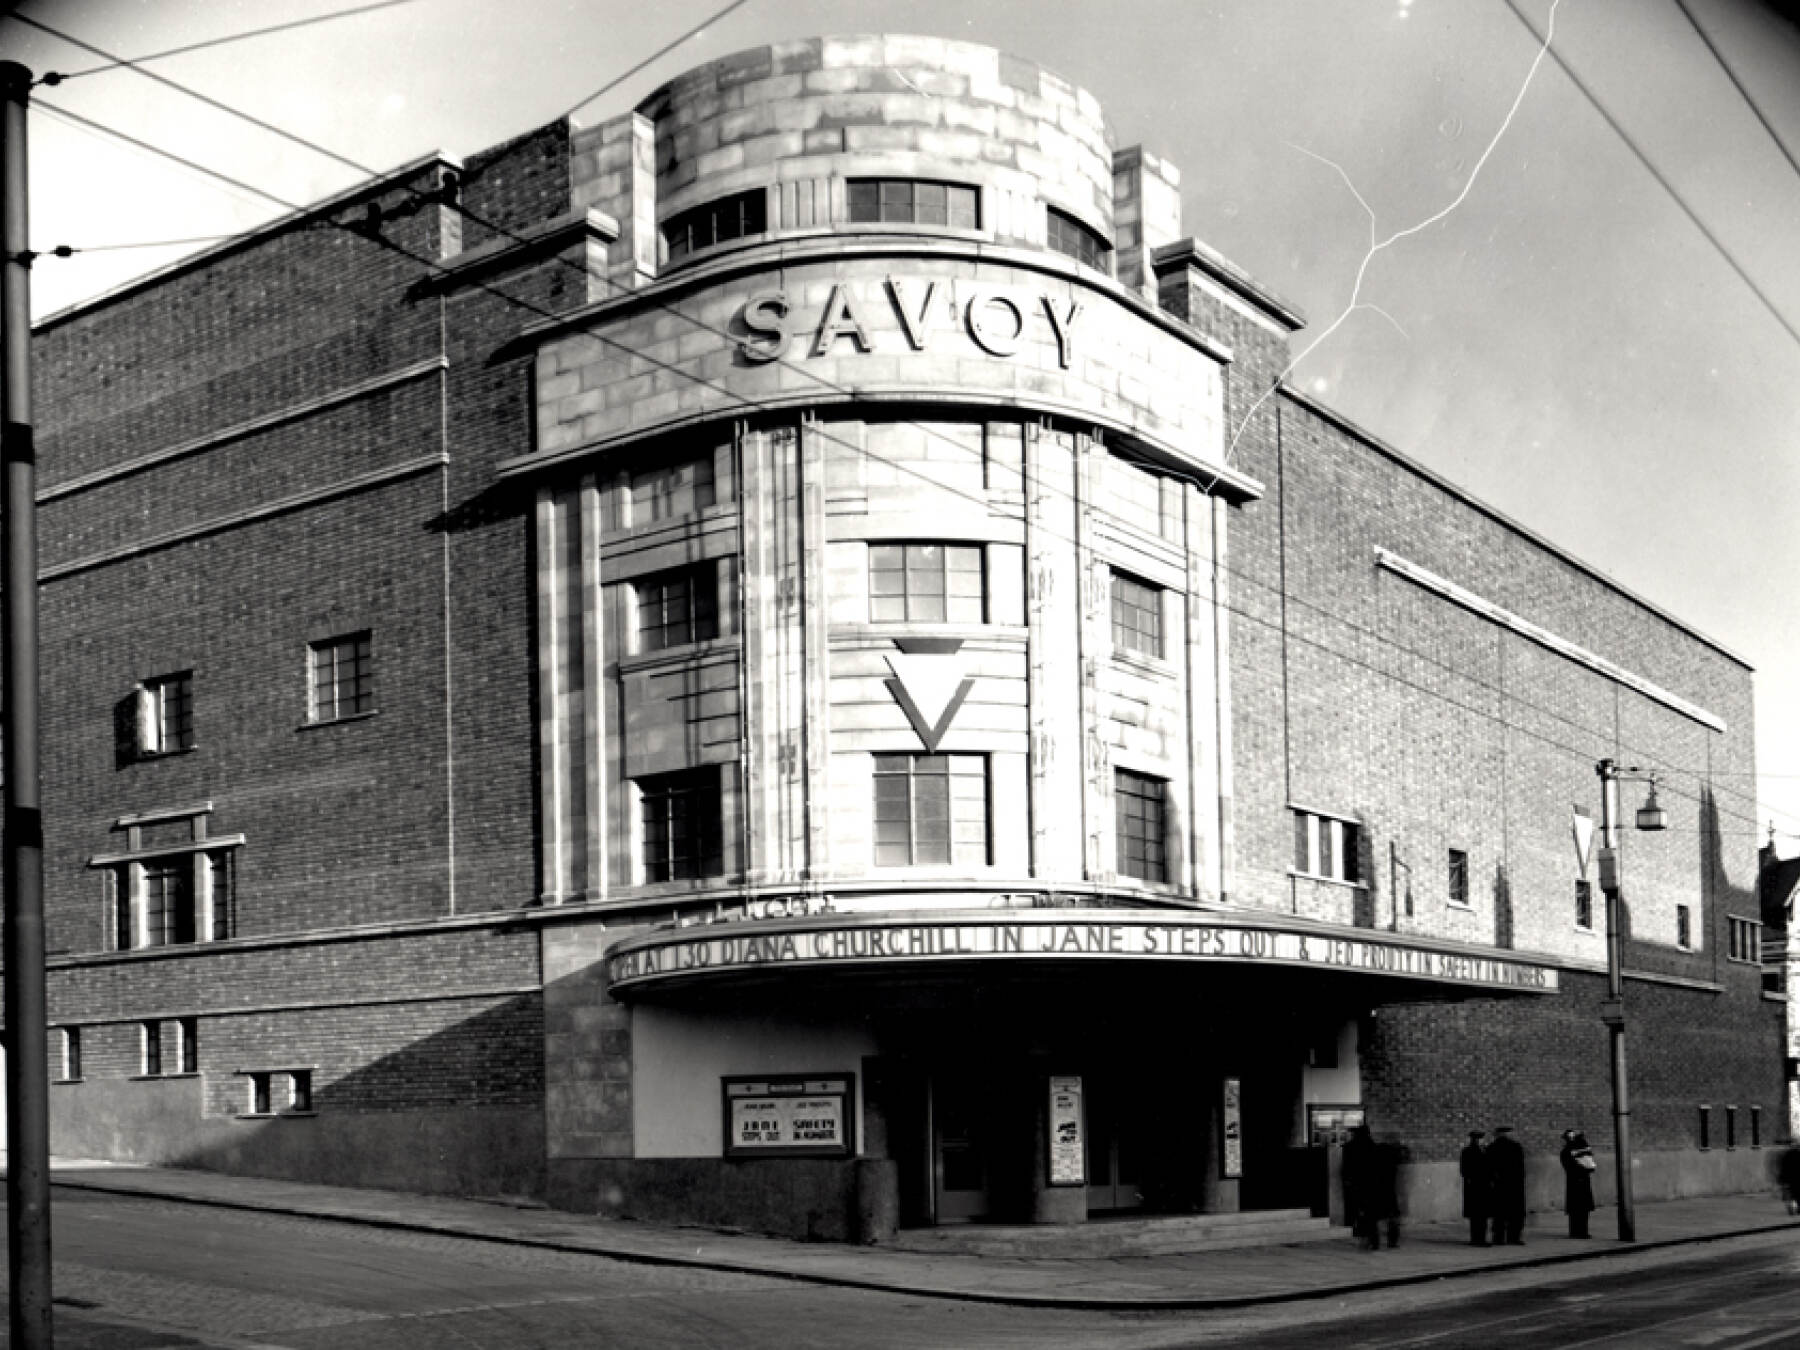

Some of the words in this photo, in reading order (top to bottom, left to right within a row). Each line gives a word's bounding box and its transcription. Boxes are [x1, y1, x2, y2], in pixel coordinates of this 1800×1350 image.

[731, 274, 1084, 369] SAVOY
[721, 934, 798, 963] DIANA
[814, 925, 972, 958] CHURCHILL
[993, 925, 1024, 953] IN
[1041, 924, 1123, 953] JANE
[1143, 925, 1226, 955] STEPS
[1240, 929, 1280, 959] OUT
[1299, 934, 1309, 961] &
